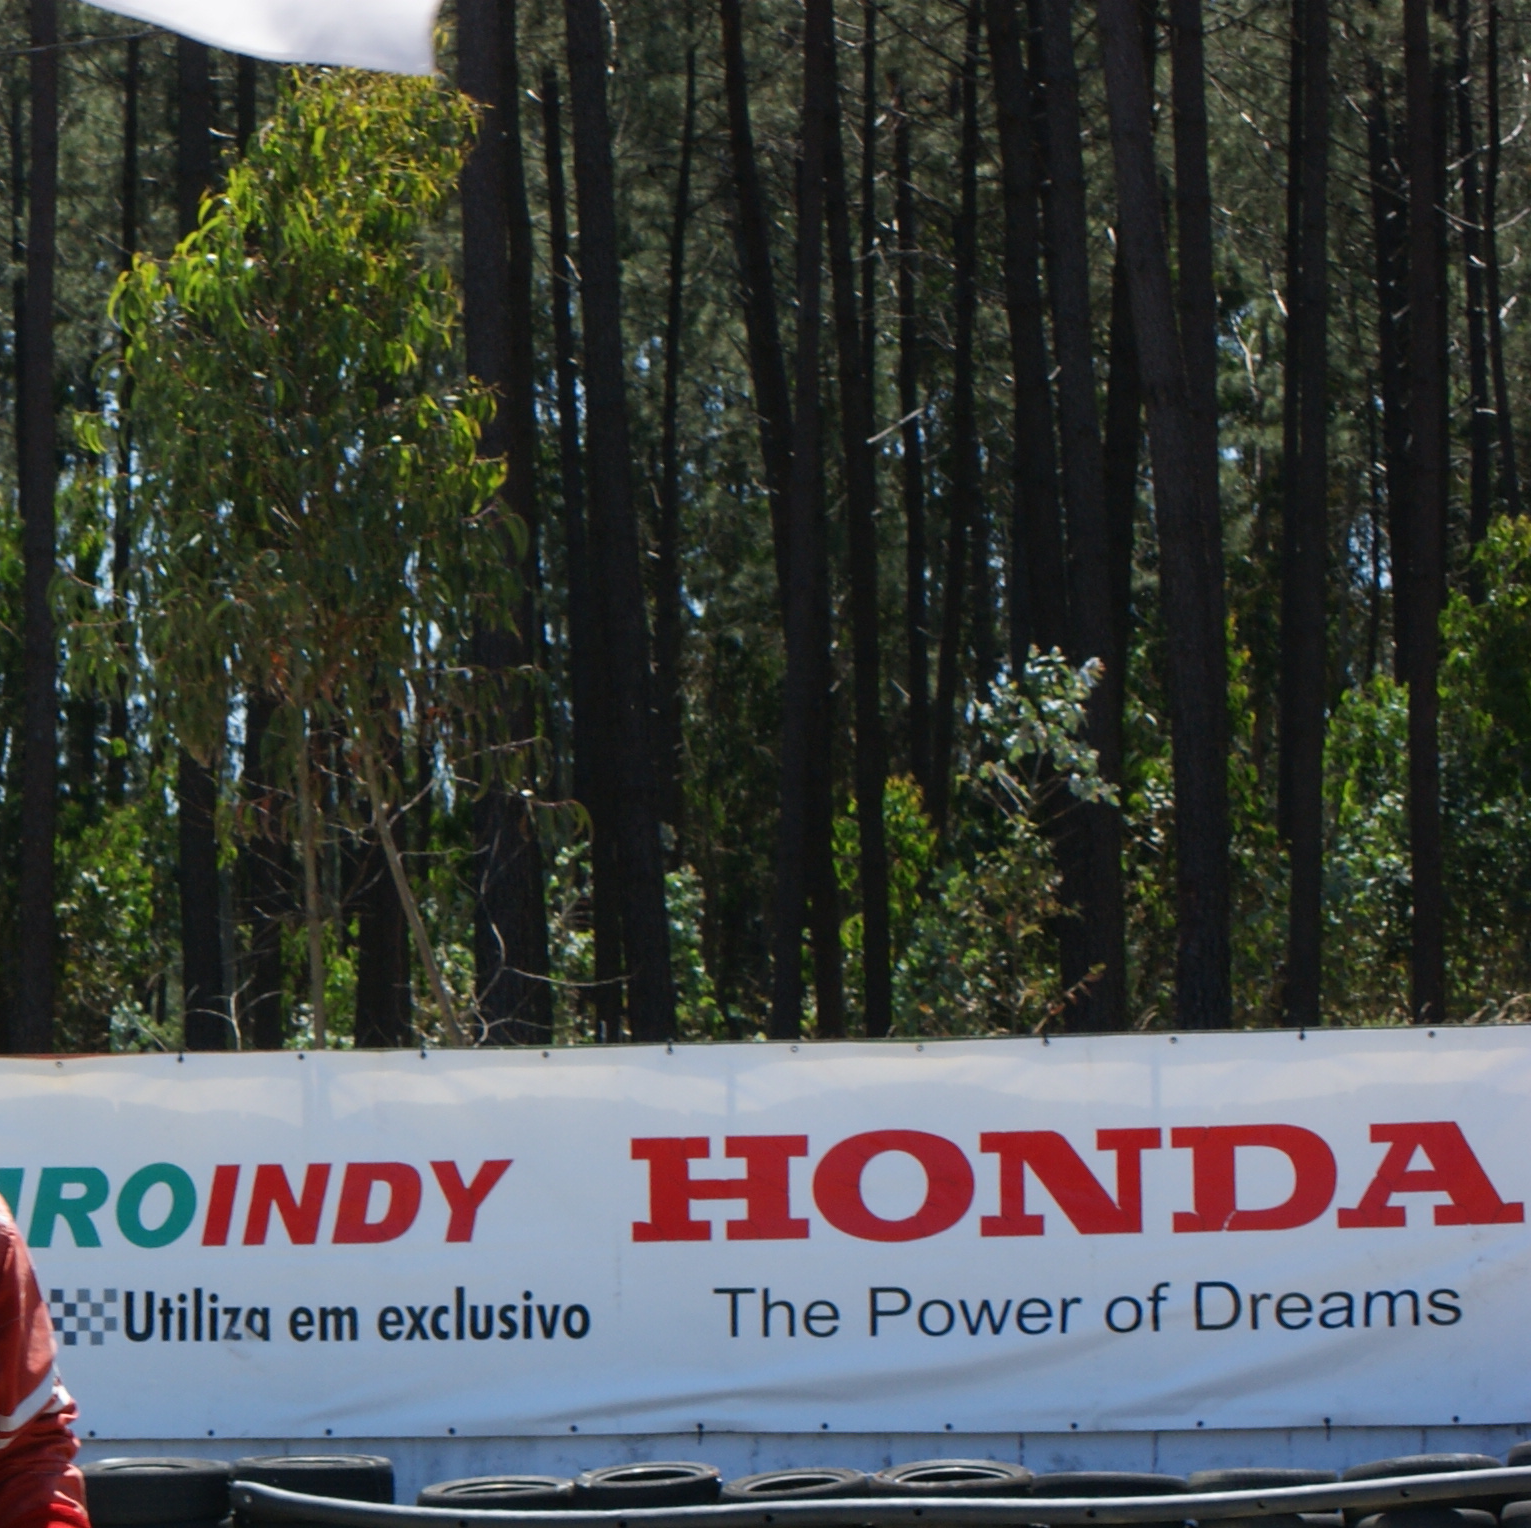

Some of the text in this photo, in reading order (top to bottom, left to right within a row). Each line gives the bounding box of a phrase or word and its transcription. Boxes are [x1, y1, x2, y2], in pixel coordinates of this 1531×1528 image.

[630, 1121, 1525, 1242] HONDA
[124, 1287, 592, 1342] Utiliza em exclusivo
[714, 1280, 1463, 1338] The Power of Dreams
